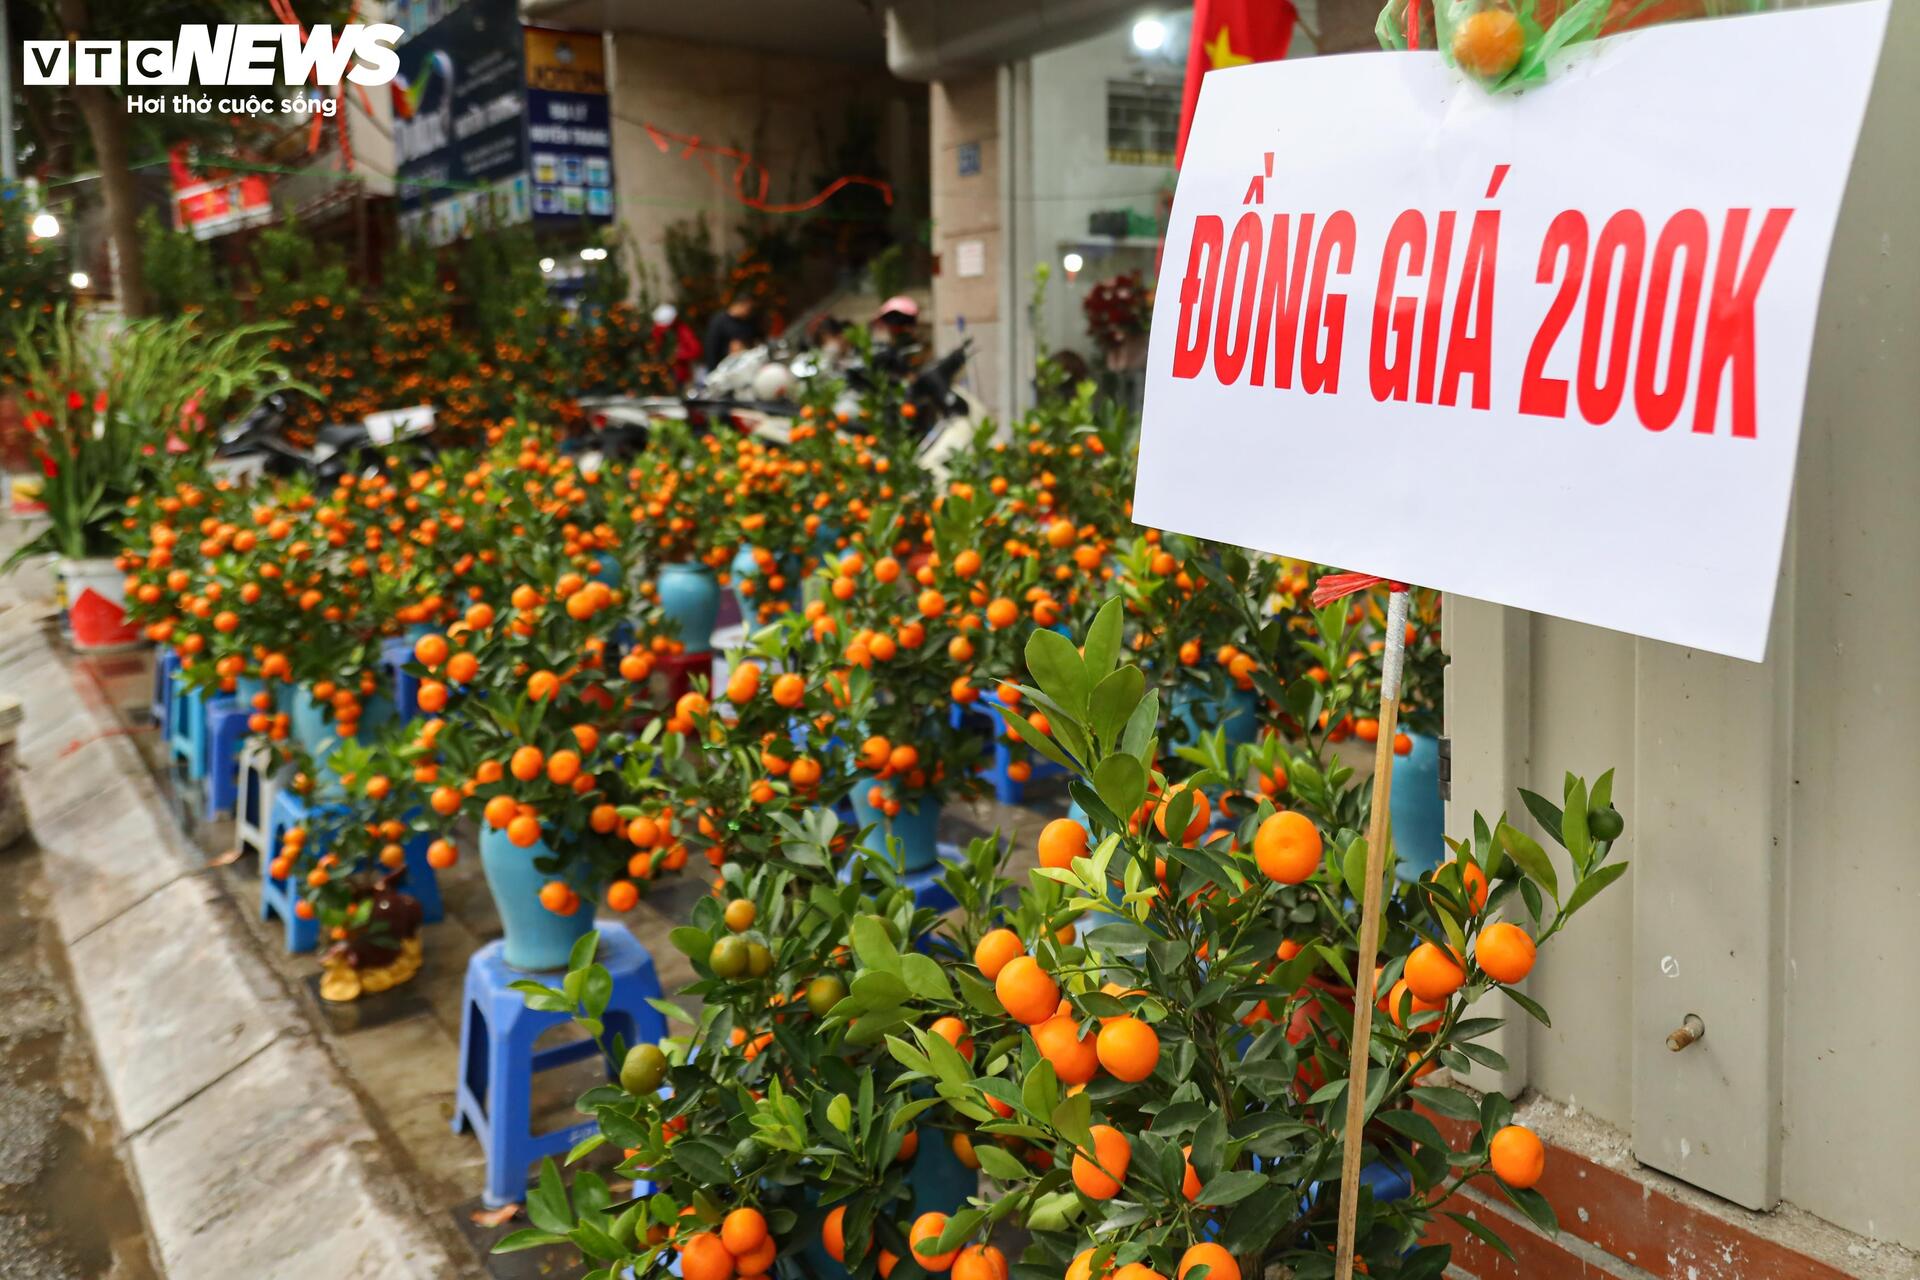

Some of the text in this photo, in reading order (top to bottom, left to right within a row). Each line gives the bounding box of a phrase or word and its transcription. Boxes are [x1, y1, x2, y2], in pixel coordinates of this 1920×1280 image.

[1172, 151, 1797, 440] ĐỒNG GIÁ 200K
